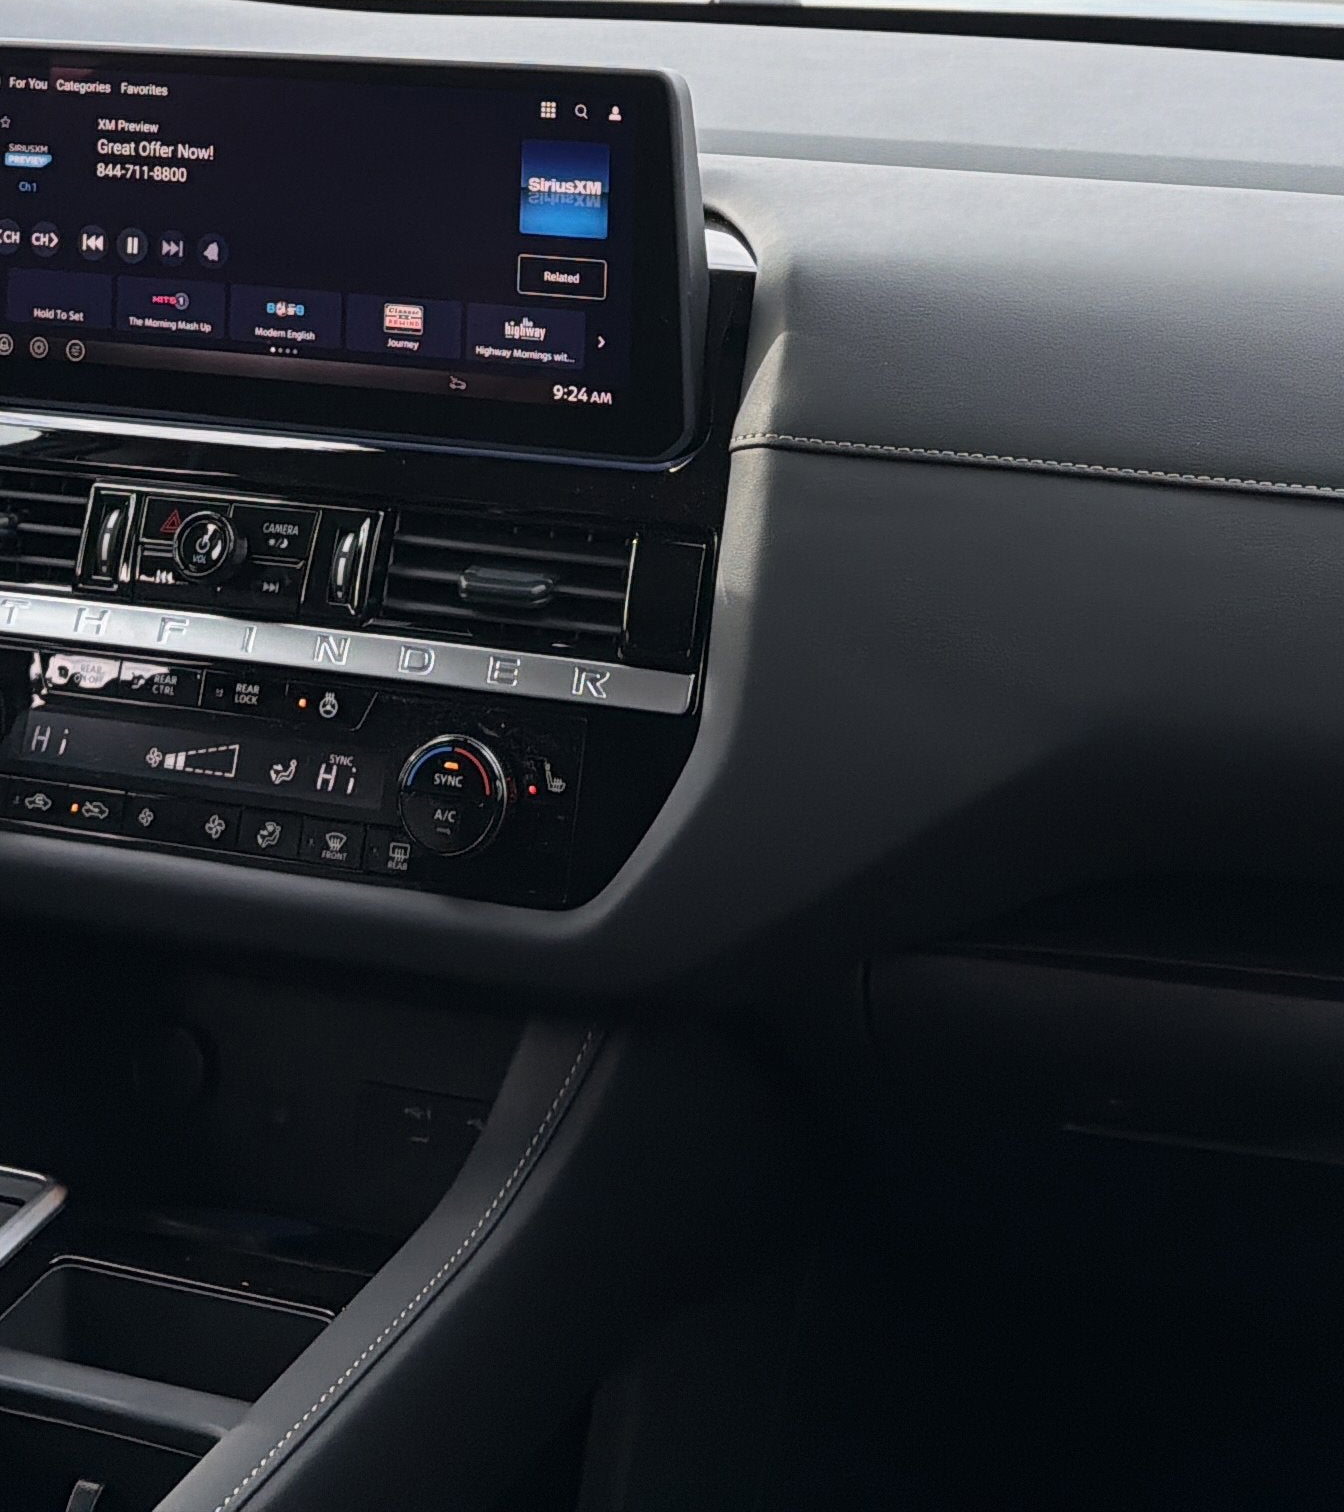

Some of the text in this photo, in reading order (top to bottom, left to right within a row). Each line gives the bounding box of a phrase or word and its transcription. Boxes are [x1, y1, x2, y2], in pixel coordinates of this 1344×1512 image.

[9, 77, 168, 96] For You Categories Favorites
[97, 119, 159, 133] XM Preview
[97, 139, 214, 160] Great Offer Now!
[8, 155, 48, 165] PREVIEW
[96, 163, 188, 183] 844-711-8800
[18, 181, 32, 192] Ch
[528, 177, 602, 196] SiriusXM
[3, 231, 50, 247] CH CH
[543, 270, 580, 284] Related
[33, 308, 84, 322] Hold To Set
[522, 316, 534, 327] the
[129, 316, 212, 333] The Morning Mash Up
[504, 322, 546, 341] highway
[254, 327, 316, 341] Modern English
[387, 338, 420, 351] Journey
[475, 345, 552, 363] Highway Mornings
[552, 384, 613, 405] 9:24 AM
[262, 522, 299, 536] CAMERA
[192, 553, 207, 564] VOL
[79, 663, 104, 674] REAR
[153, 674, 178, 686] REAR
[152, 685, 175, 696] CTRL
[235, 683, 260, 694] REAR
[234, 694, 258, 705] LOCK
[31, 725, 70, 755] Hi
[329, 753, 354, 767] SYNC
[316, 763, 357, 795] Hi
[433, 773, 463, 788] SYNC
[433, 808, 457, 824] A/C
[321, 850, 347, 862] FRONT
[387, 860, 408, 871] REAR
